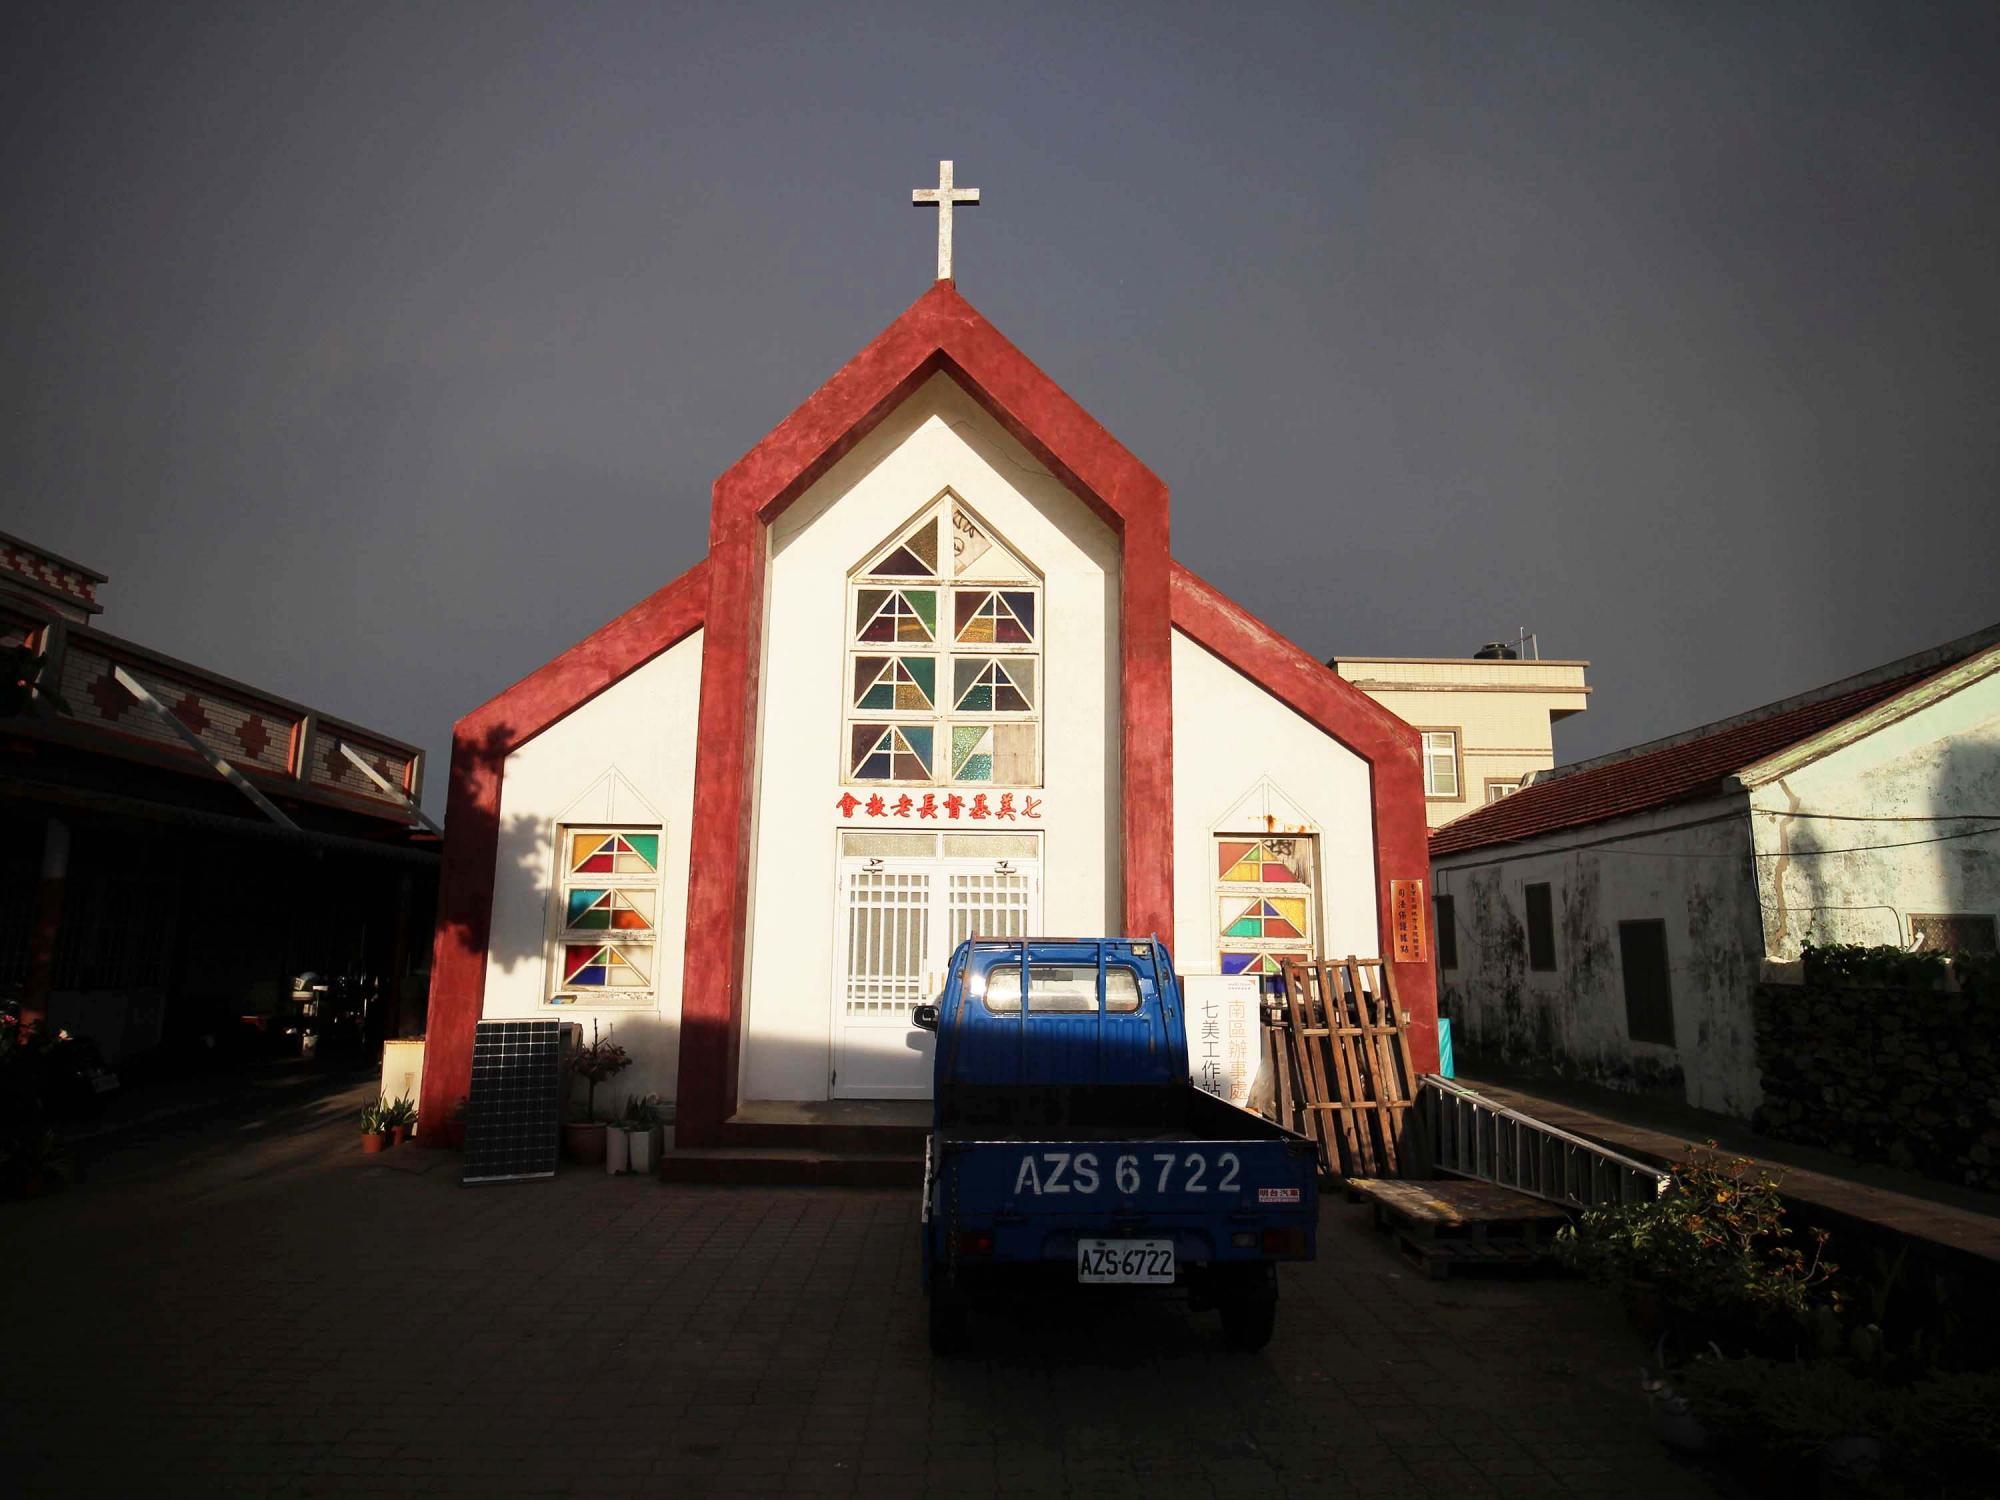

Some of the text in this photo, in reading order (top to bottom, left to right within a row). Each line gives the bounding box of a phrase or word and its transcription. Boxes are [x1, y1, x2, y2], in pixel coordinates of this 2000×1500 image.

[836, 792, 1042, 821] 七美基督長老教會
[1201, 1000, 1220, 1097] 七美工作站
[1227, 1000, 1248, 1100] 南區辦事處
[1014, 1153, 1241, 1195] AZS 6722
